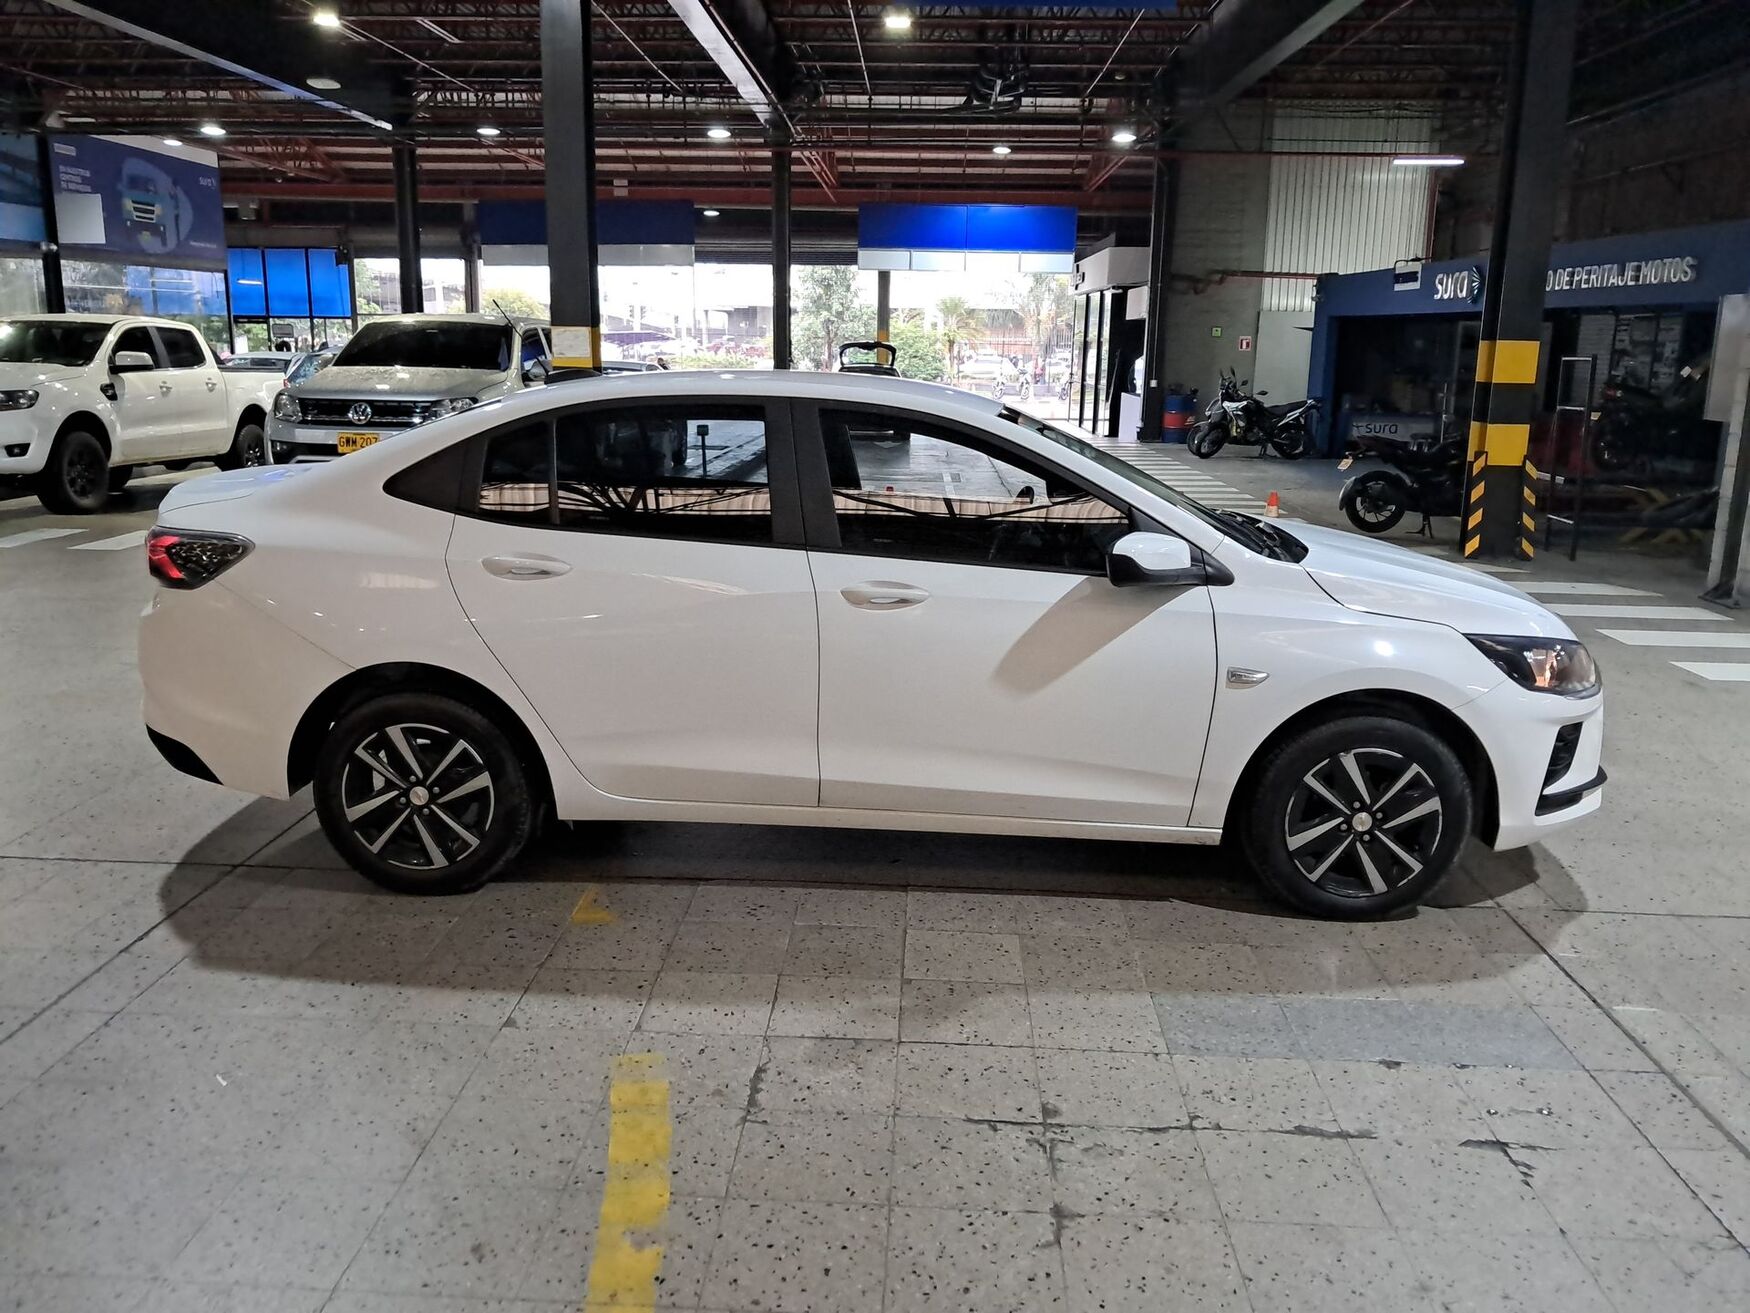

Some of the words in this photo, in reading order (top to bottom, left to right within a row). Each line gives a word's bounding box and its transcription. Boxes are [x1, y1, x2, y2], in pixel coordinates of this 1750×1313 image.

[1434, 271, 1469, 300] sura
[1554, 267, 1573, 291] DE
[1572, 261, 1639, 289] PERITAJE
[1638, 256, 1695, 285] MOTOS
[1365, 423, 1398, 434] sura
